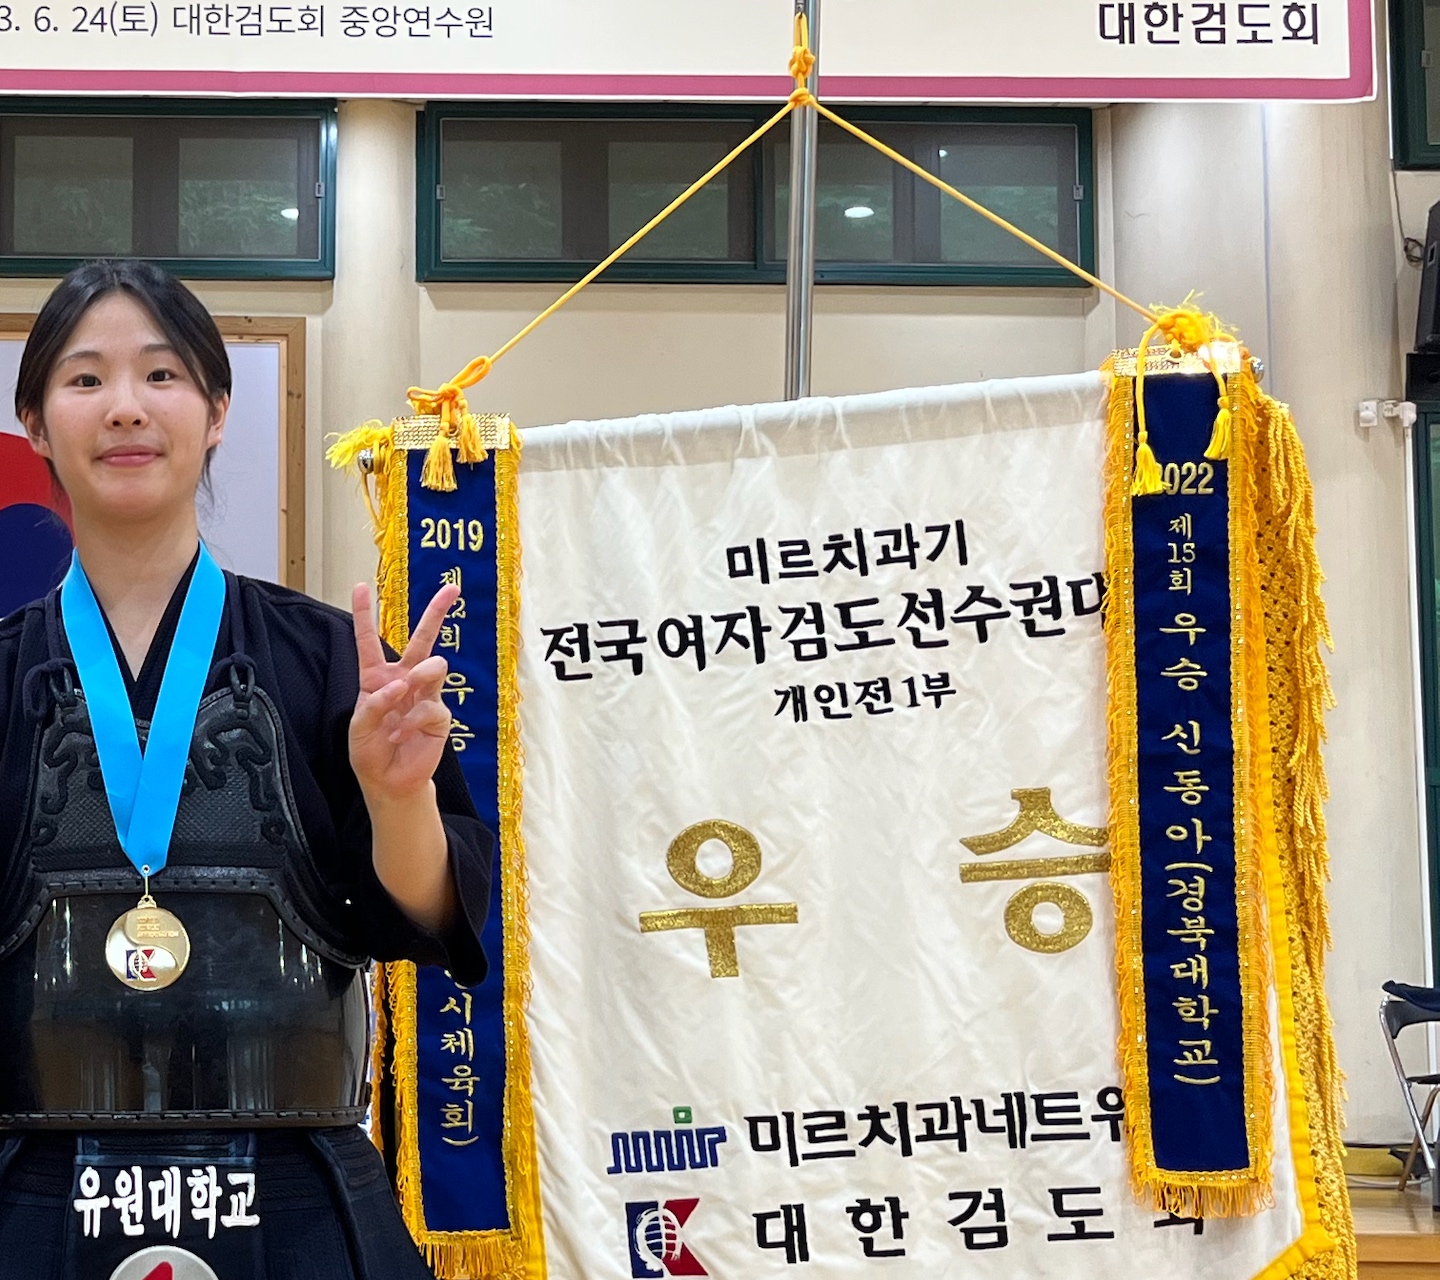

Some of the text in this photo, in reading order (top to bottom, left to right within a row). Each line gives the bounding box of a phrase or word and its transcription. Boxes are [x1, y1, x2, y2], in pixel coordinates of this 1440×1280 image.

[34, 5, 59, 33] 6.
[71, 0, 159, 37] 24(토)
[173, 3, 325, 38] 대한검도회
[339, 5, 493, 40] 중앙연수원
[1098, 1, 1319, 46] 대한검도회
[420, 517, 484, 552] 2019
[726, 518, 970, 586] 미르치과기
[1167, 512, 1196, 596] 제15회
[439, 566, 467, 653] 제2회
[1159, 612, 1208, 691] 우승
[774, 672, 957, 724] 개인전 1부
[440, 970, 481, 1147] 시체육회)
[744, 1086, 1125, 1168] 미르치과네트
[73, 1165, 261, 1240] 유원대학교
[752, 1185, 1204, 1264] 대한검도
